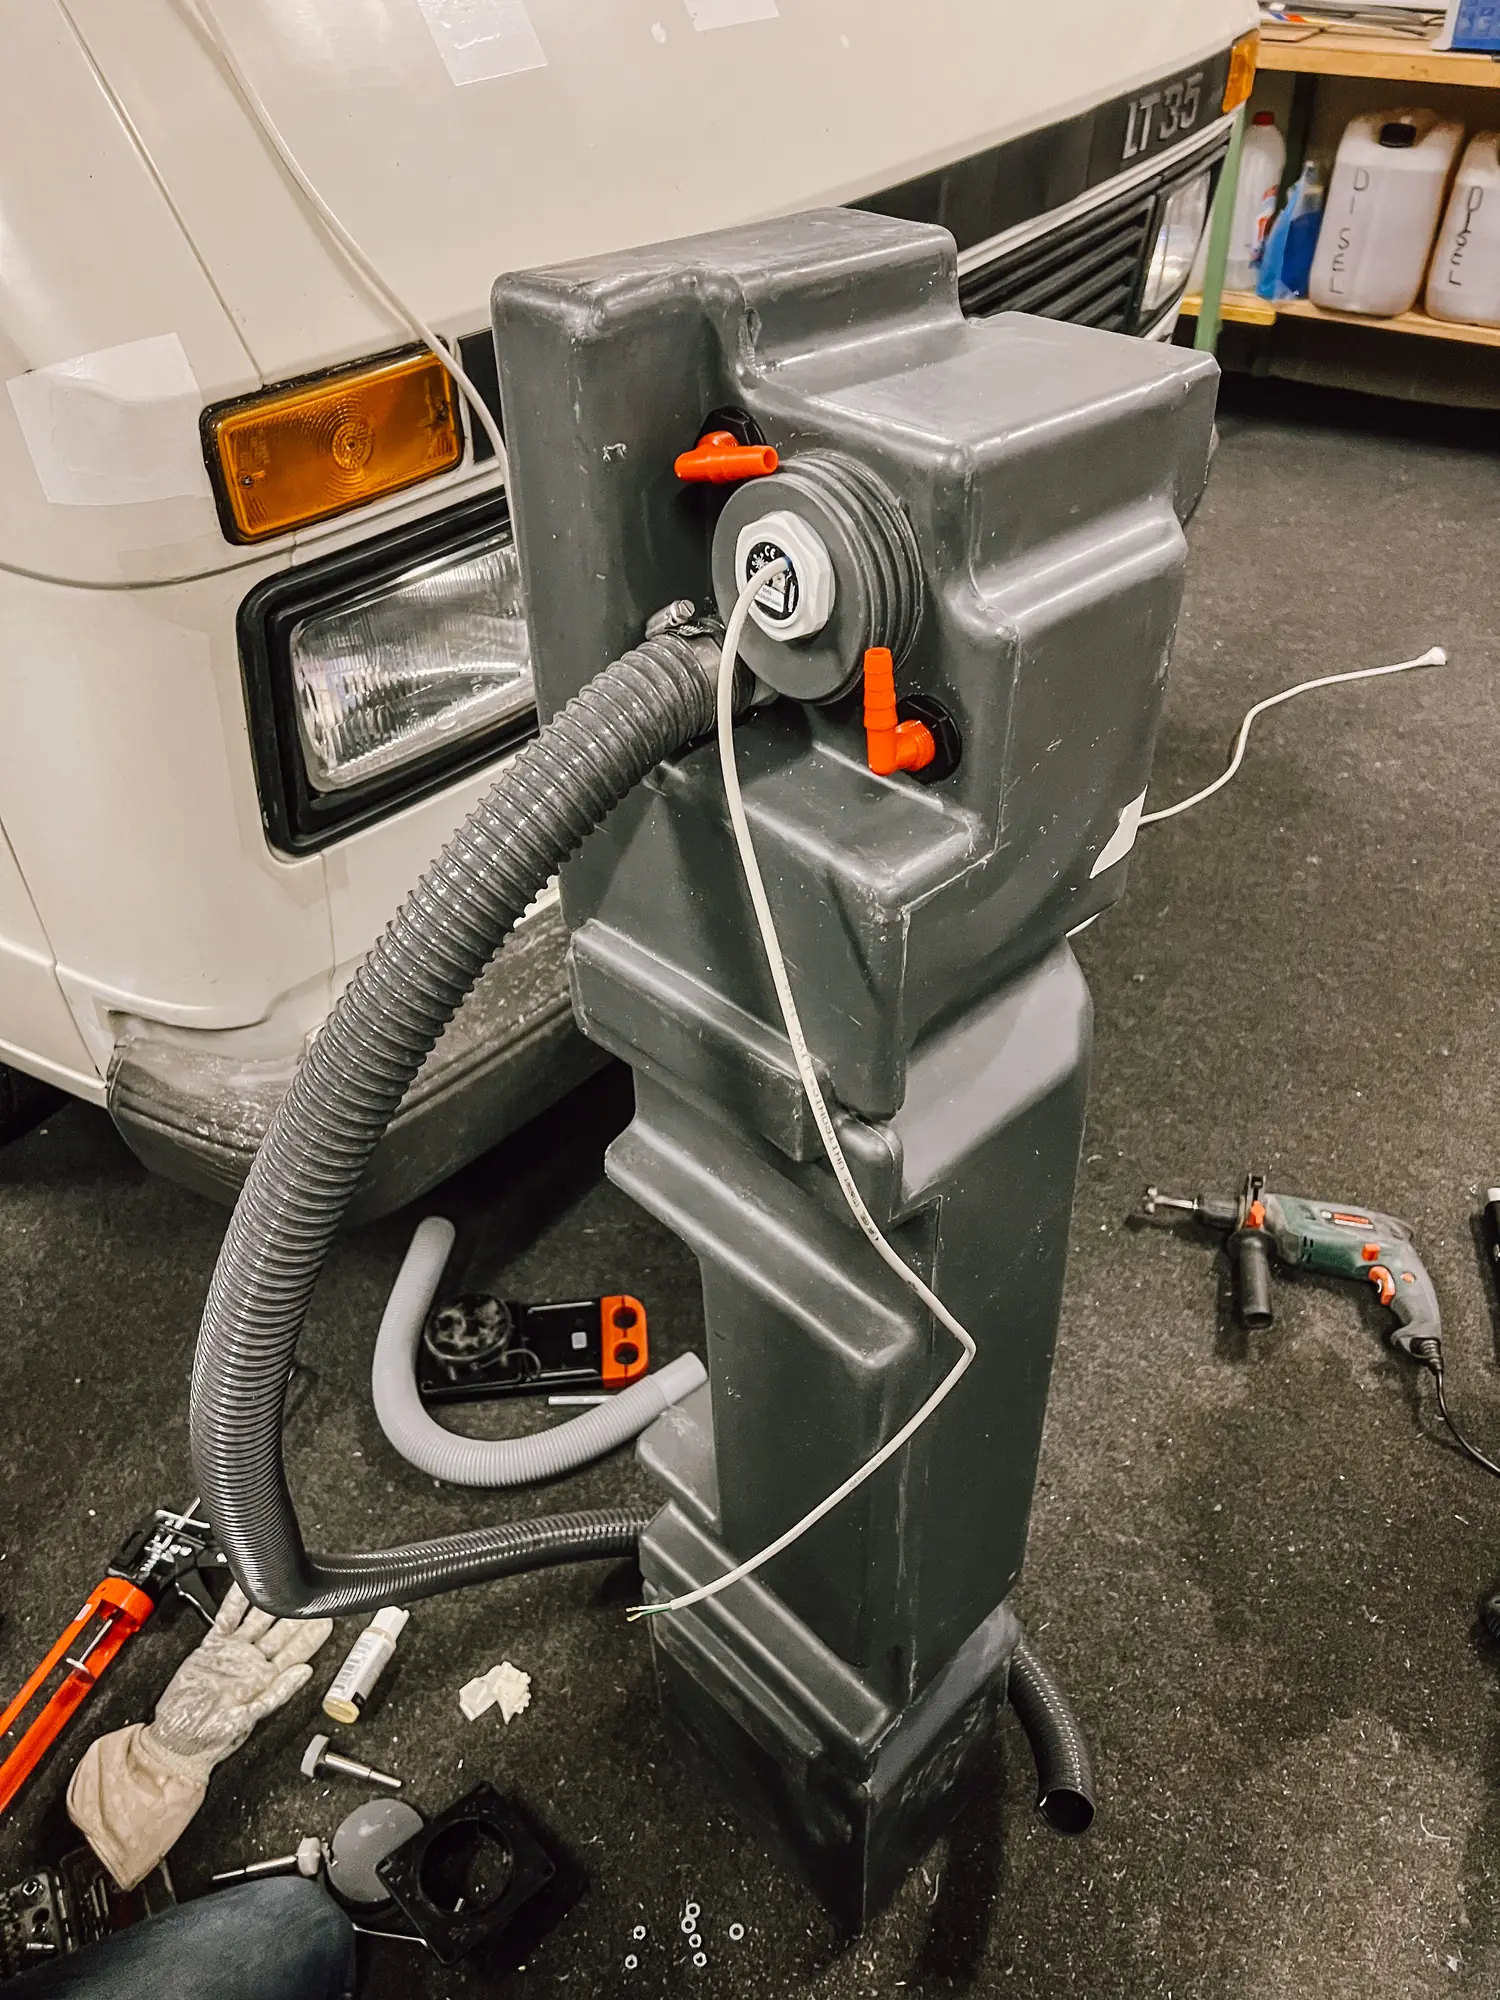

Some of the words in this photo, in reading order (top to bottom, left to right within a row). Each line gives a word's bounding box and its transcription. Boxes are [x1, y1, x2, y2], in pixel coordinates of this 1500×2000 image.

[1122, 92, 1161, 160] LT
[1159, 72, 1204, 139] 35
[1328, 167, 1370, 295] DISEL
